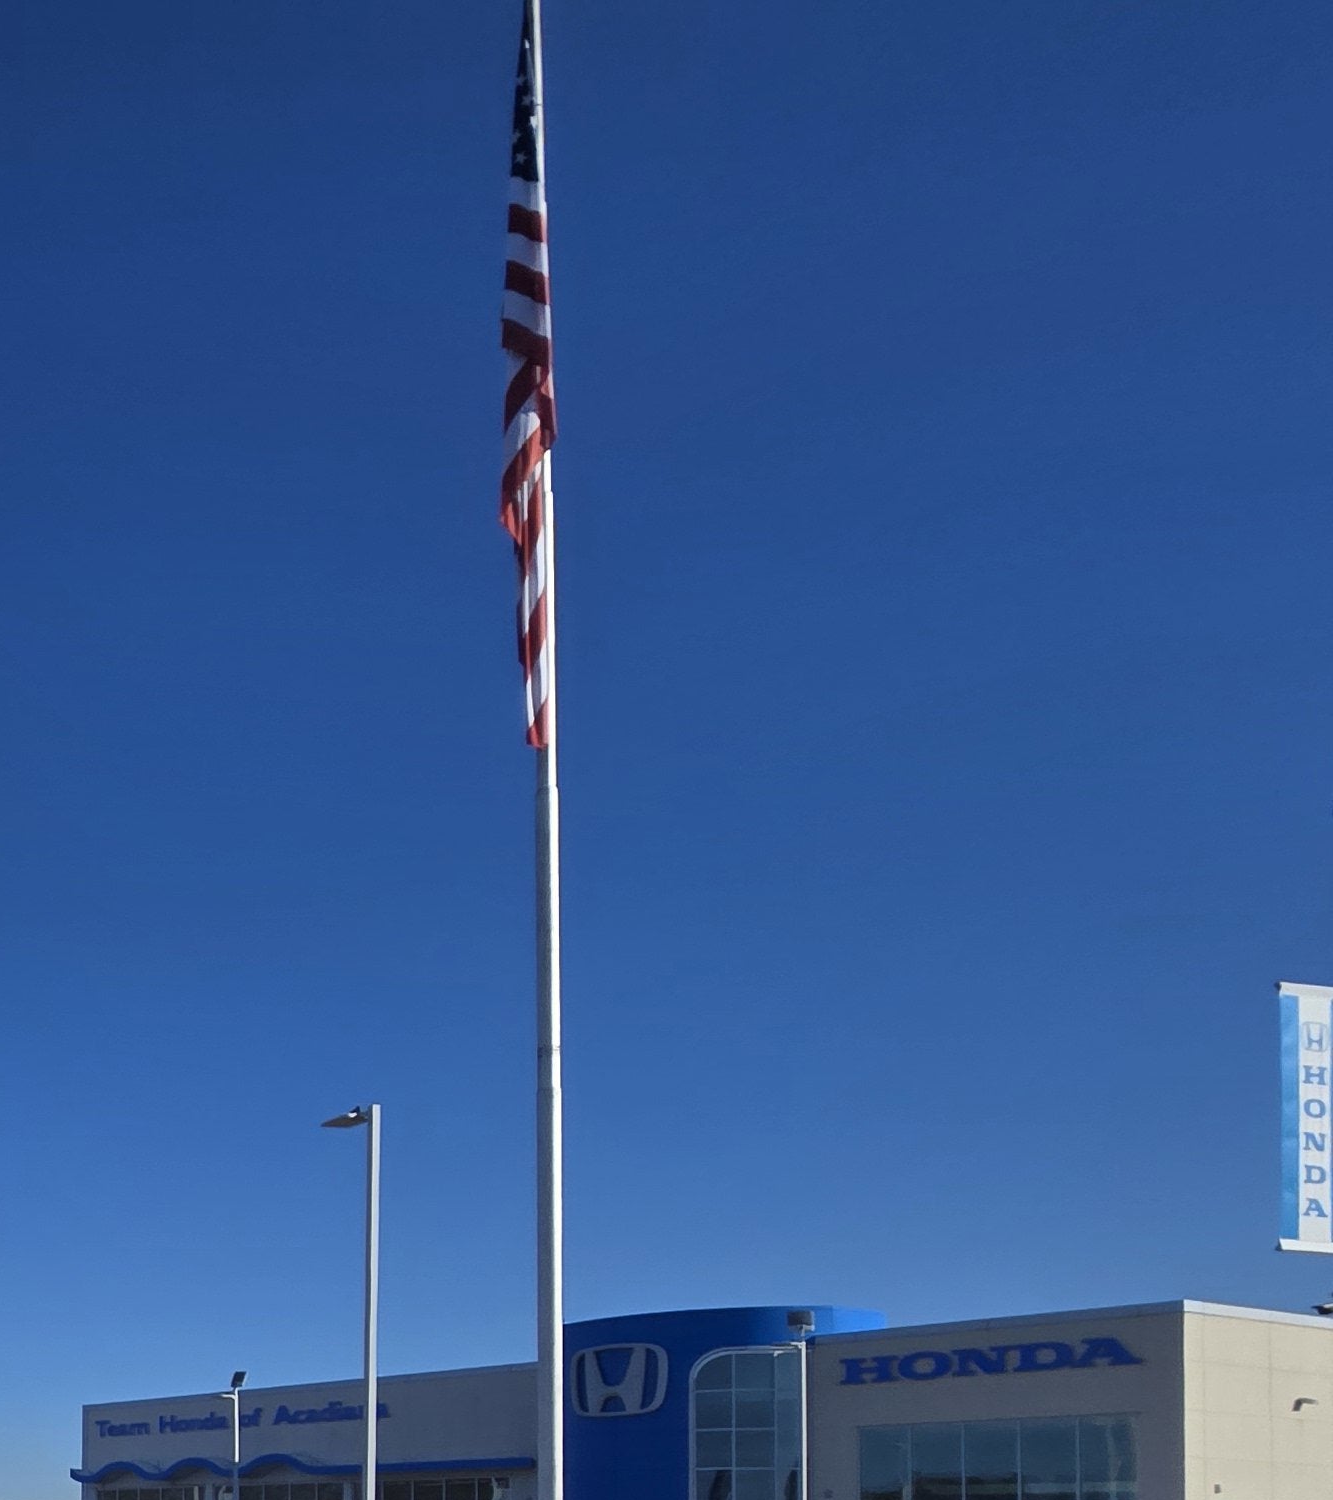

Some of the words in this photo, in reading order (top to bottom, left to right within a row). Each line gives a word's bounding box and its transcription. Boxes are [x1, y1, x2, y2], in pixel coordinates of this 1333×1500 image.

[1302, 1064, 1329, 1218] HONDA
[839, 1336, 1145, 1386] HONDA
[95, 1419, 151, 1438] Team
[158, 1411, 230, 1434] Honda
[240, 1407, 263, 1428] of
